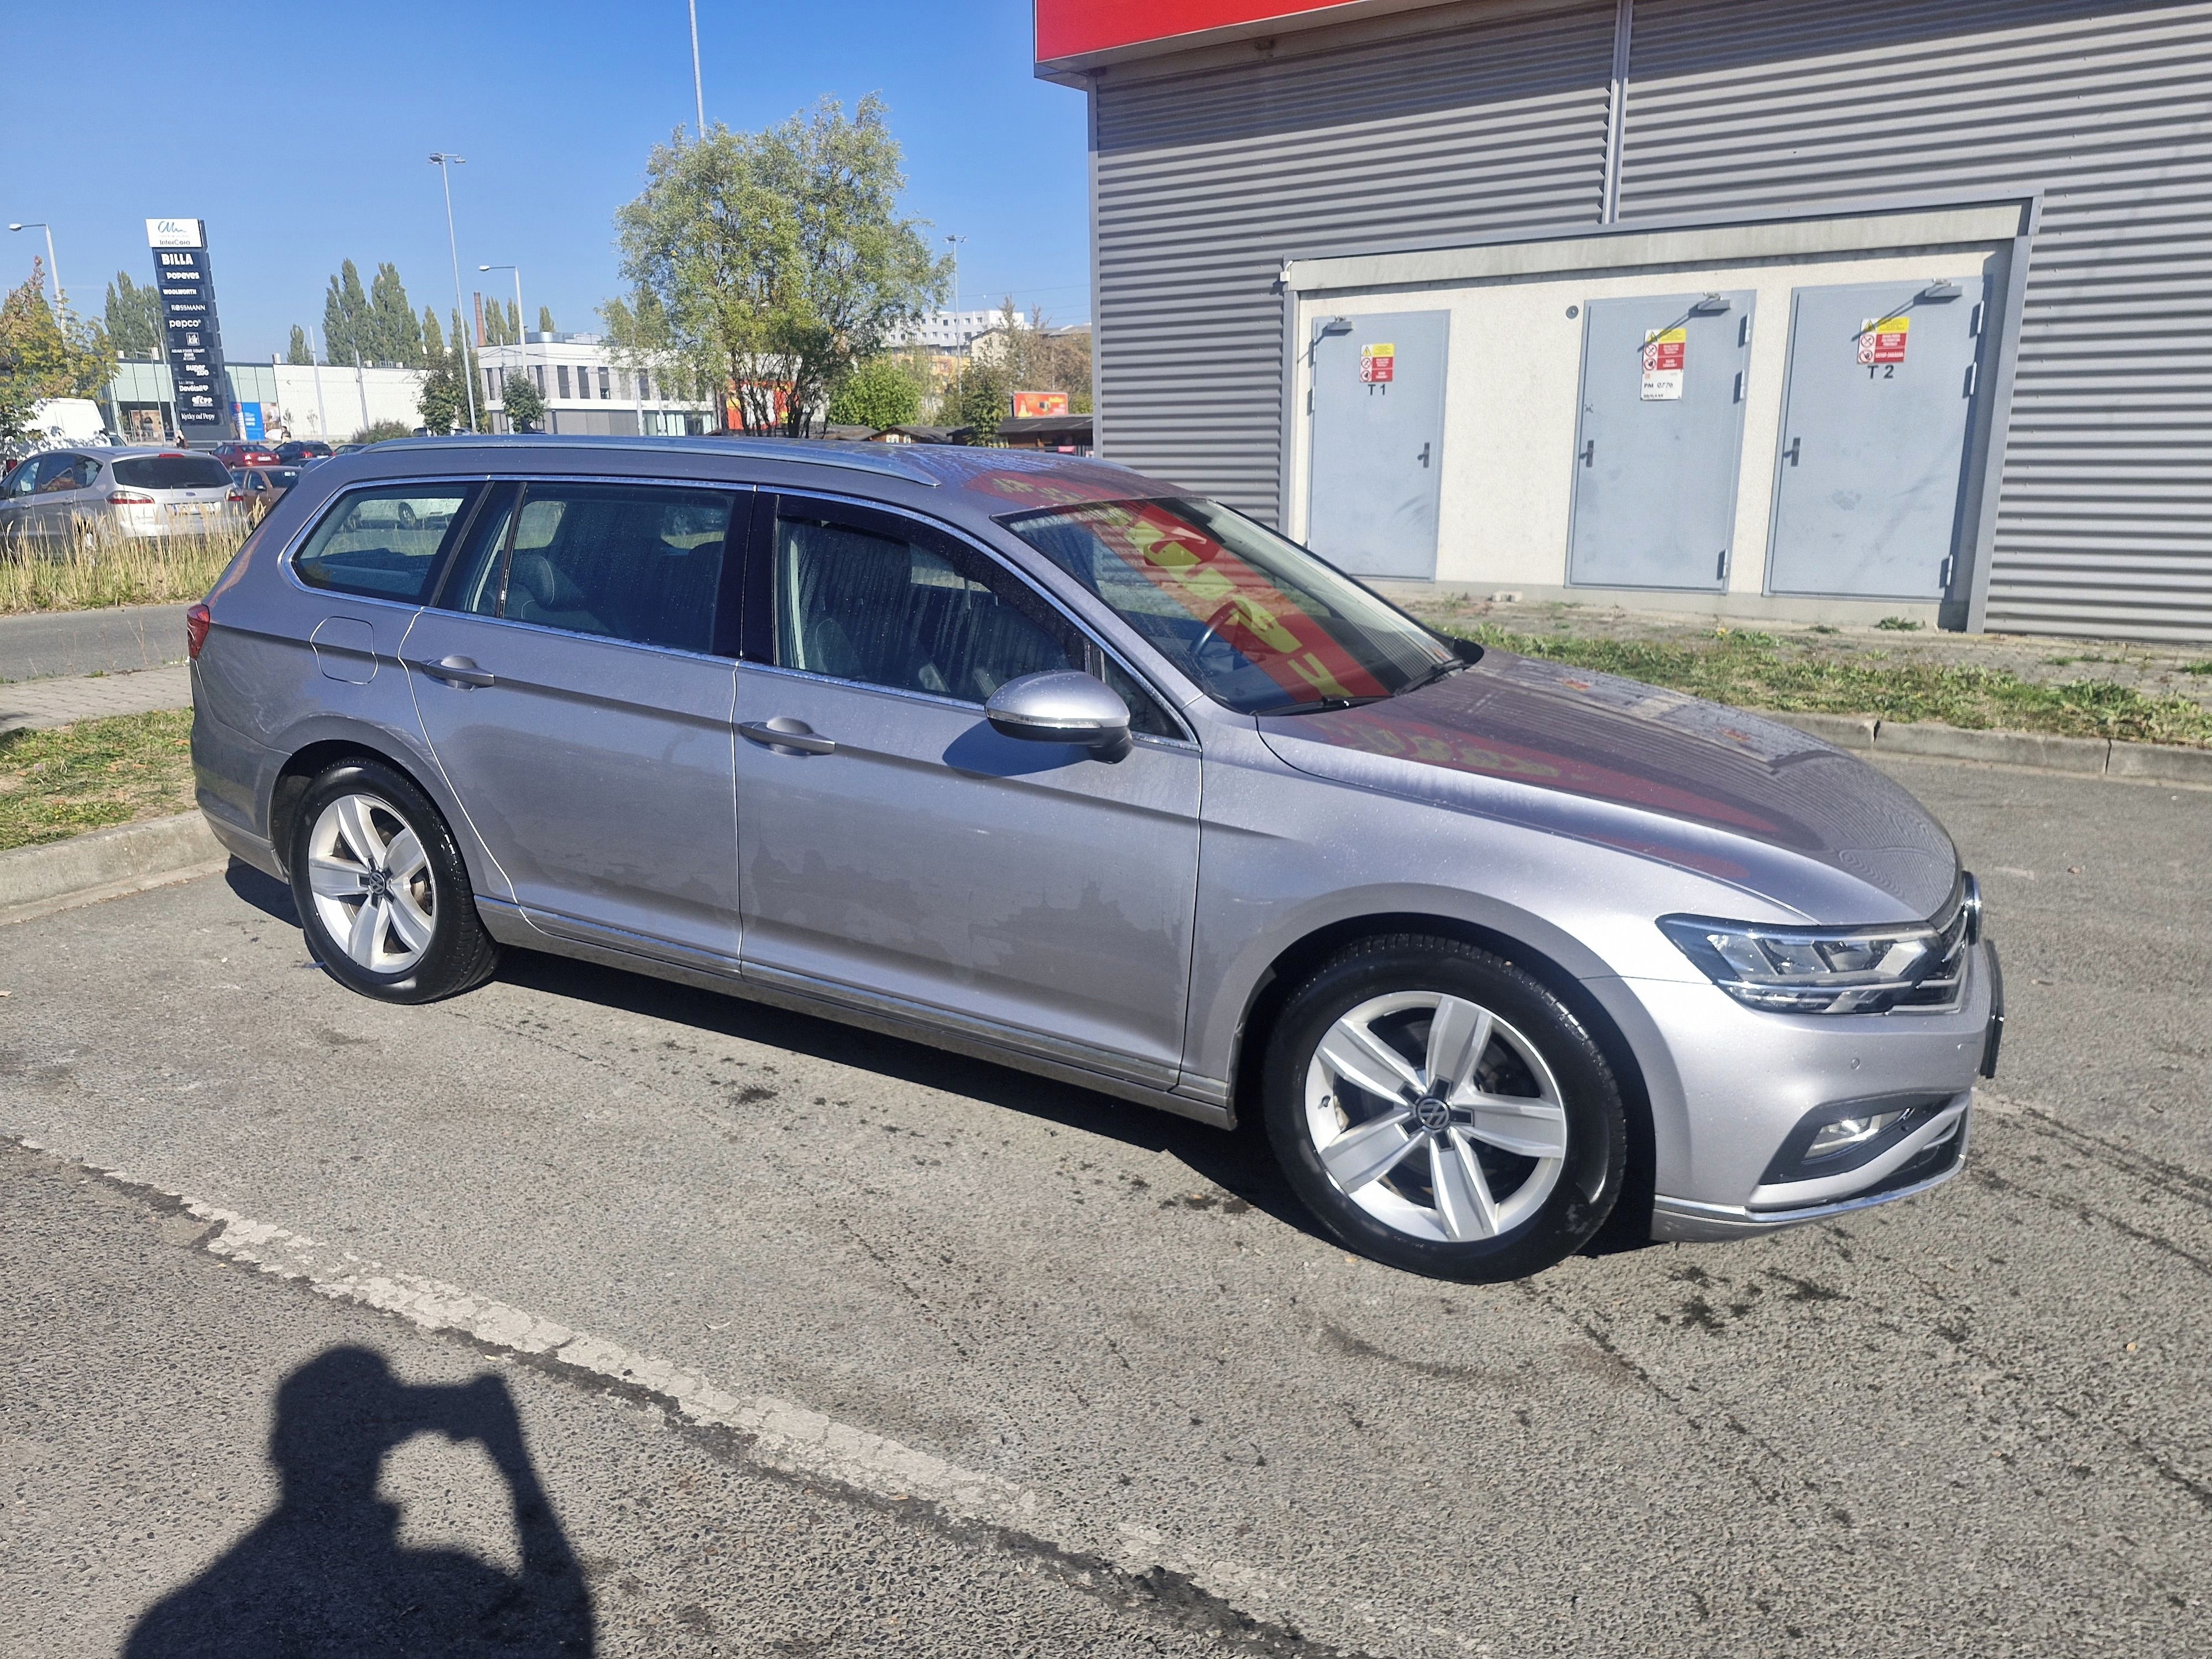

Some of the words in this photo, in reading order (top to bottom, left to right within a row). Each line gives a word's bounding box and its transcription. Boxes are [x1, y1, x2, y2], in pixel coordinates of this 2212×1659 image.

[161, 253, 194, 265] BILLA
[1867, 365, 1879, 379] T
[1884, 364, 1894, 379] 2
[1368, 384, 1376, 396] T
[1380, 383, 1385, 396] 1
